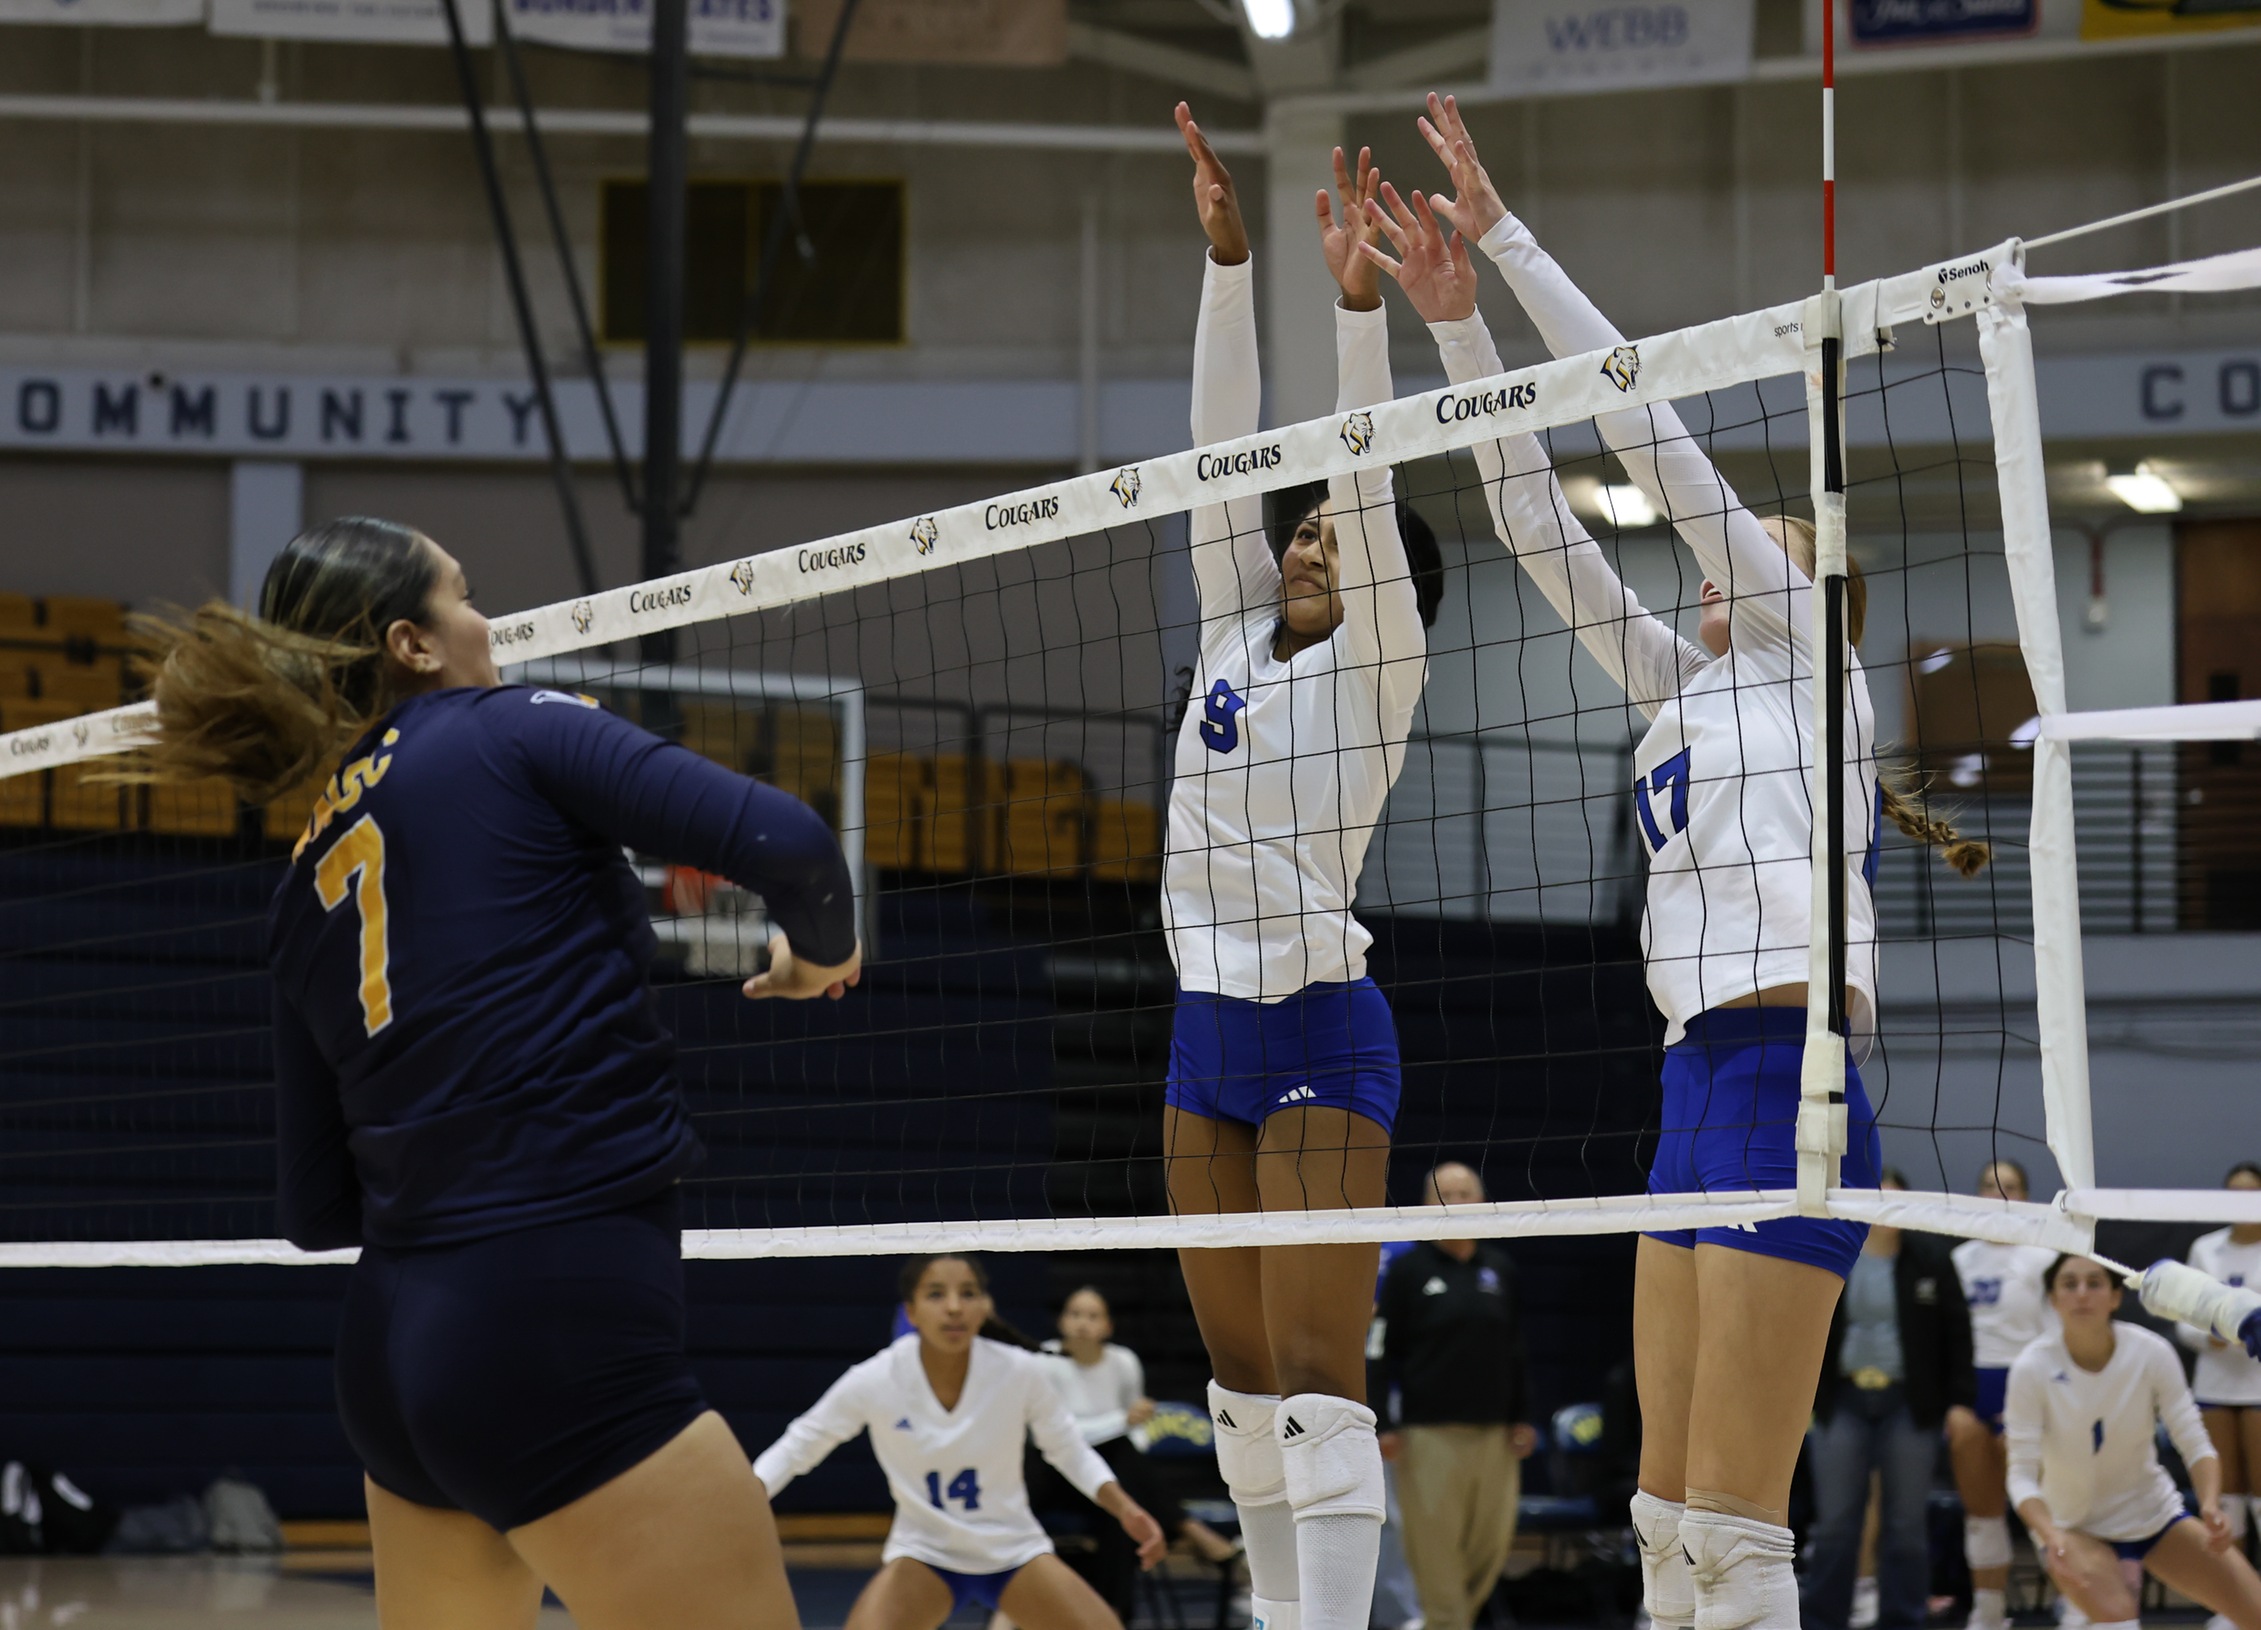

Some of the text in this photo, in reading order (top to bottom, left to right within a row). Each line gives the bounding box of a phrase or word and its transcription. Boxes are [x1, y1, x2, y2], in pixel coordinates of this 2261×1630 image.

[1545, 6, 1689, 53] WEBB
[1948, 259, 1990, 281] Senoh
[1774, 321, 1799, 338] sports
[2140, 362, 2261, 421] CO
[1199, 679, 1246, 754] 9
[1635, 745, 1691, 853] 17
[314, 812, 393, 1039] 7
[926, 1468, 981, 1510] 14
